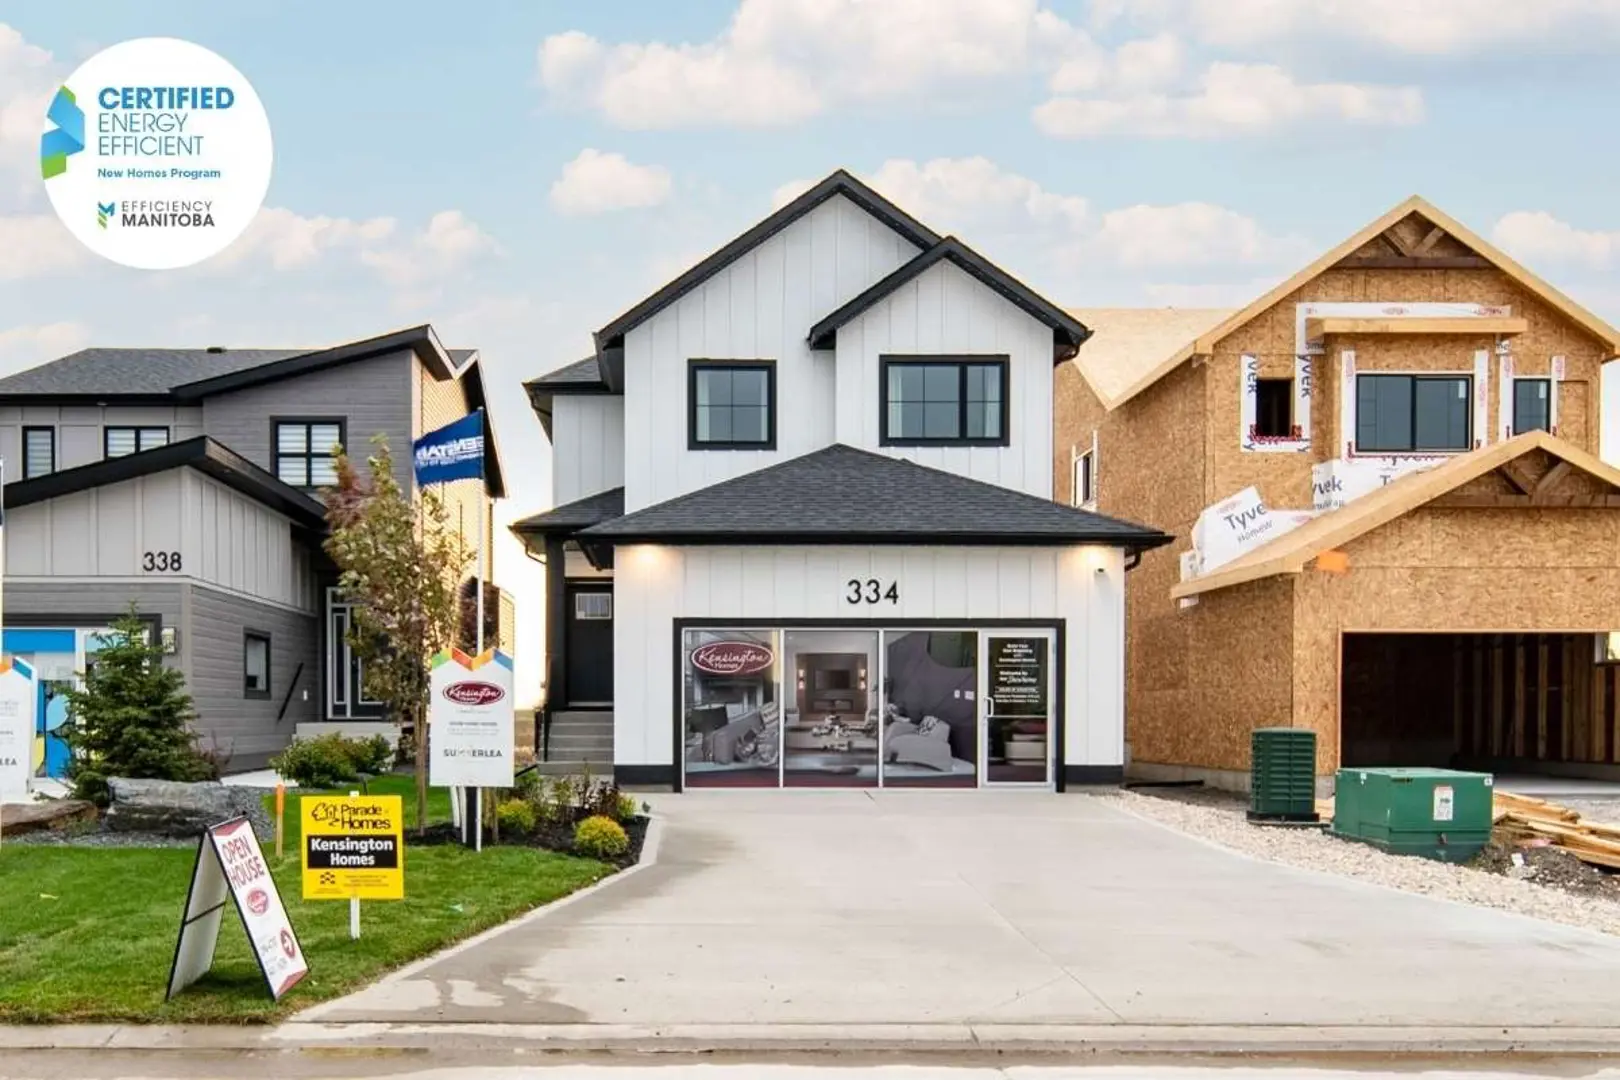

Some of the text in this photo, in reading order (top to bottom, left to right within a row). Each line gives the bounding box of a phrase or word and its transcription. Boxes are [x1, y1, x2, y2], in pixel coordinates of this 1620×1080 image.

[143, 552, 182, 572] 338
[846, 579, 899, 604] 334
[698, 647, 769, 666] Kensington
[341, 803, 383, 816] Parade
[340, 818, 392, 830] Homes
[221, 835, 253, 865] OPEN
[311, 837, 393, 853] Kensington
[330, 852, 375, 866] Homes
[228, 856, 265, 891] HOUSE
